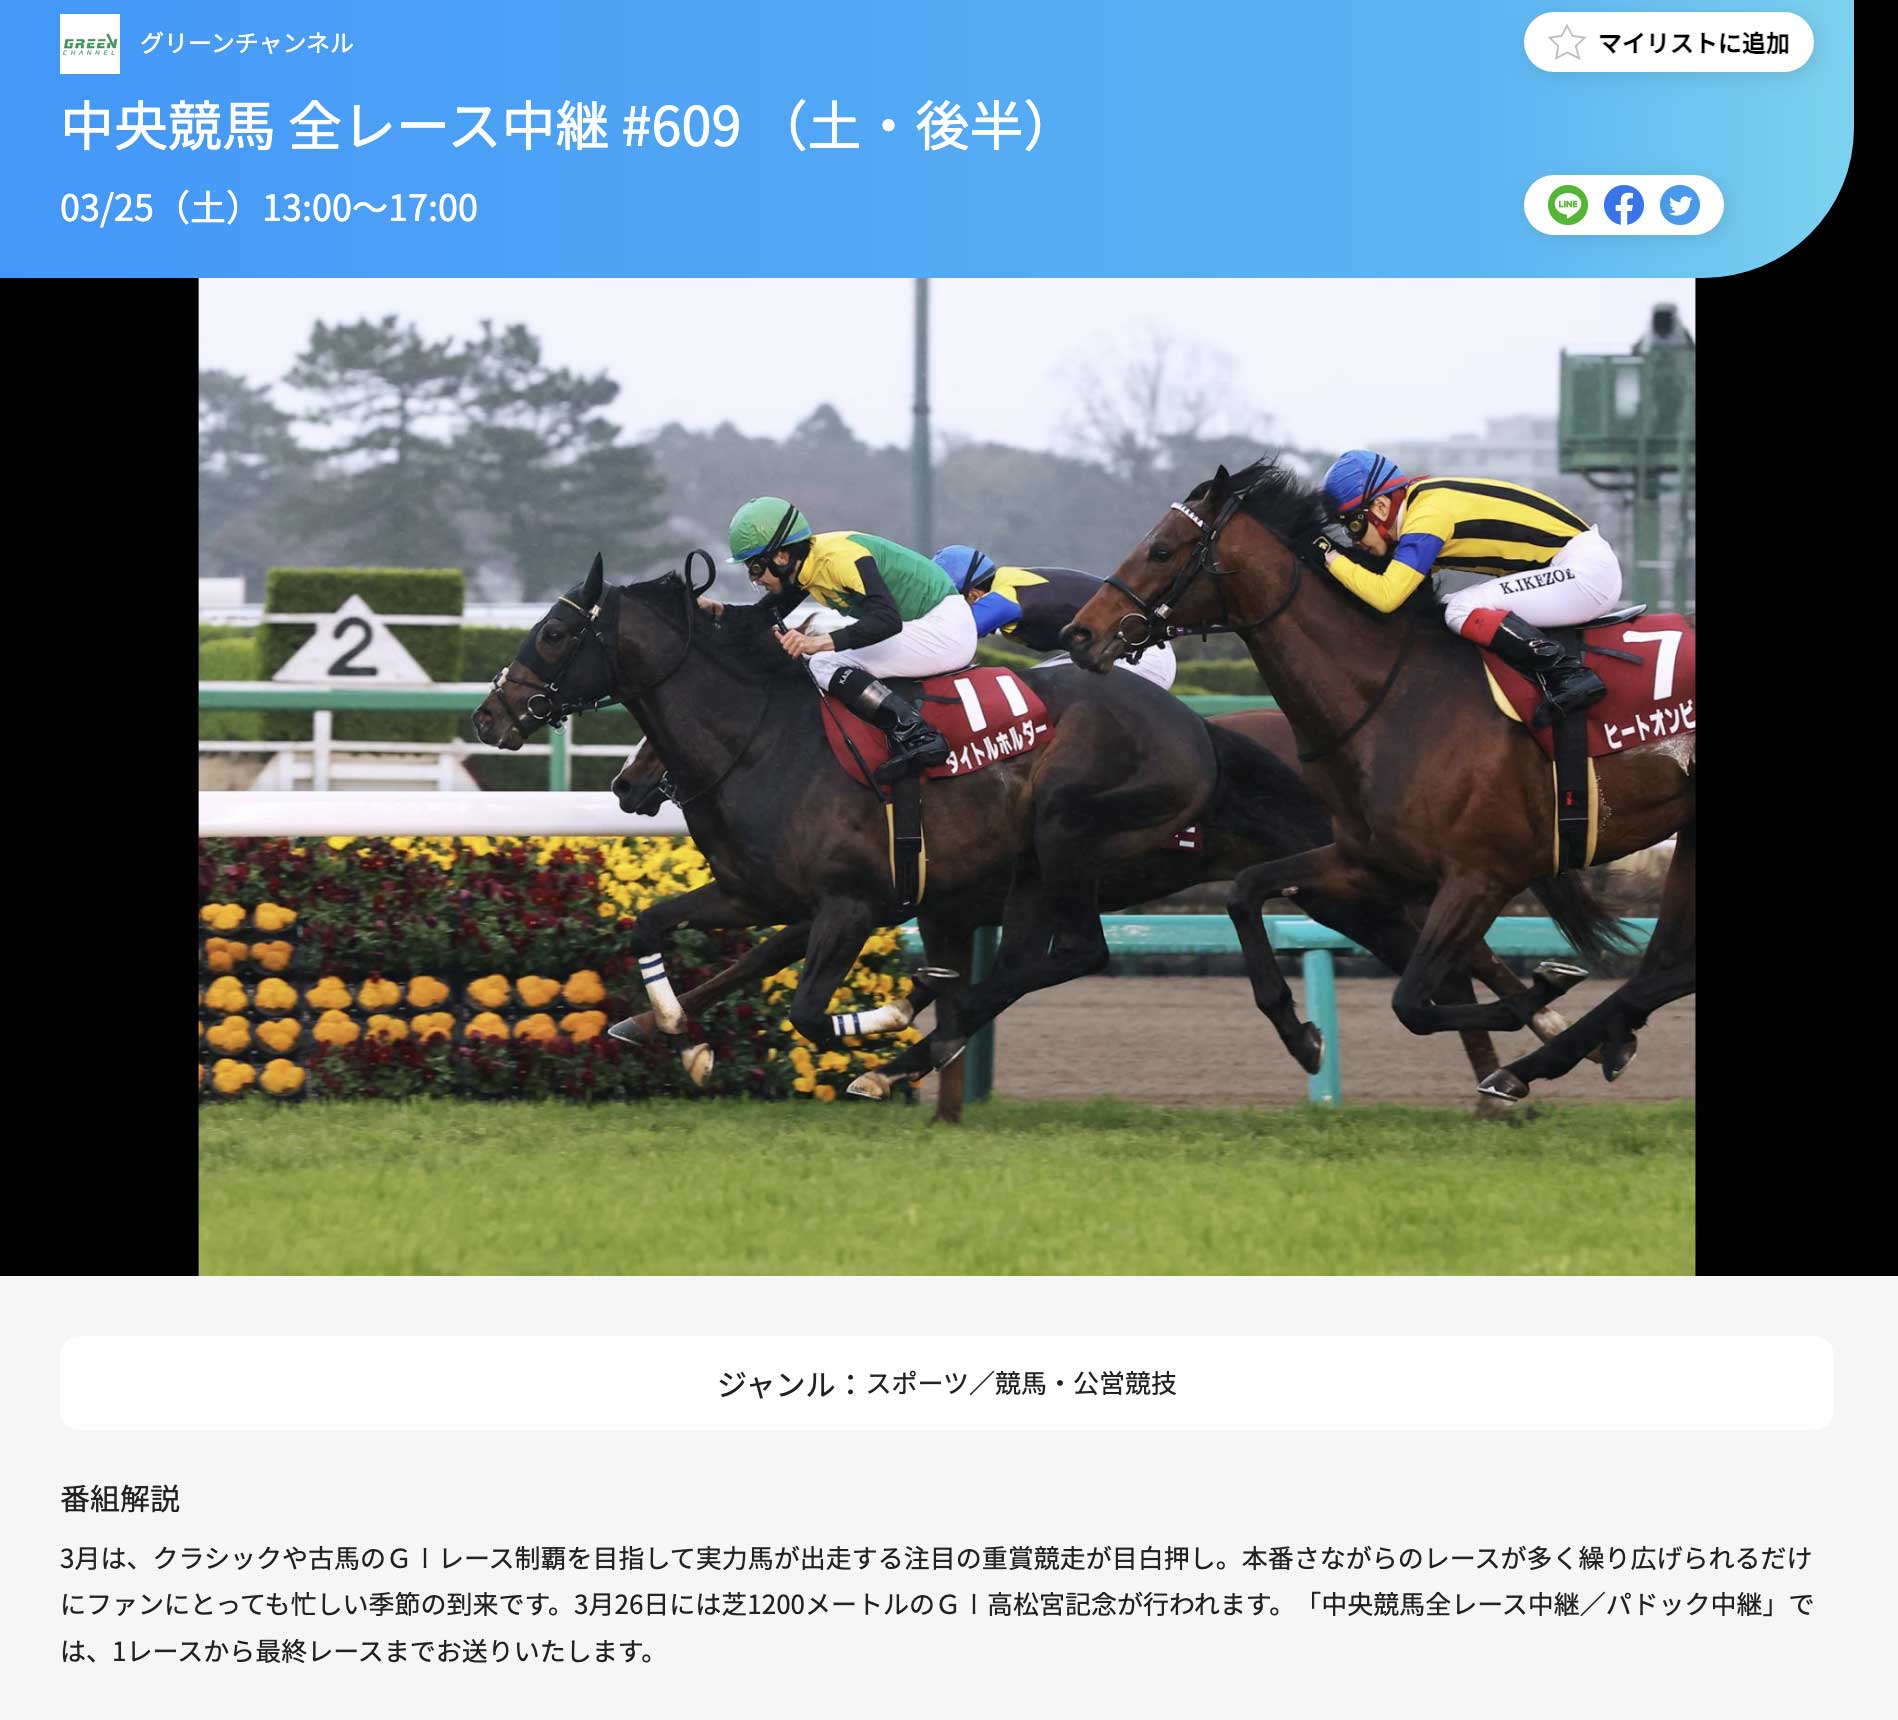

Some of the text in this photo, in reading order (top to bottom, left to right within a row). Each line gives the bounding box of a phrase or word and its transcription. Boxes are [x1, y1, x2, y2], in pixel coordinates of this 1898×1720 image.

[63, 33, 118, 49] GREEN
[141, 31, 354, 55] グリーンチャンネル
[1599, 31, 1790, 55] マイリストに追加
[64, 98, 1041, 152] 中央競馬 全レース中継 #609 （土・後半）
[1558, 200, 1578, 208] LINE
[328, 617, 378, 677] 2
[1622, 630, 1683, 701] 7
[953, 675, 1029, 733] 11
[945, 719, 1048, 775] タイトルホルダー
[60, 1483, 180, 1514] 番組解説
[62, 1638, 652, 1664] は、1レースから最終レースまでお送りいたします。
